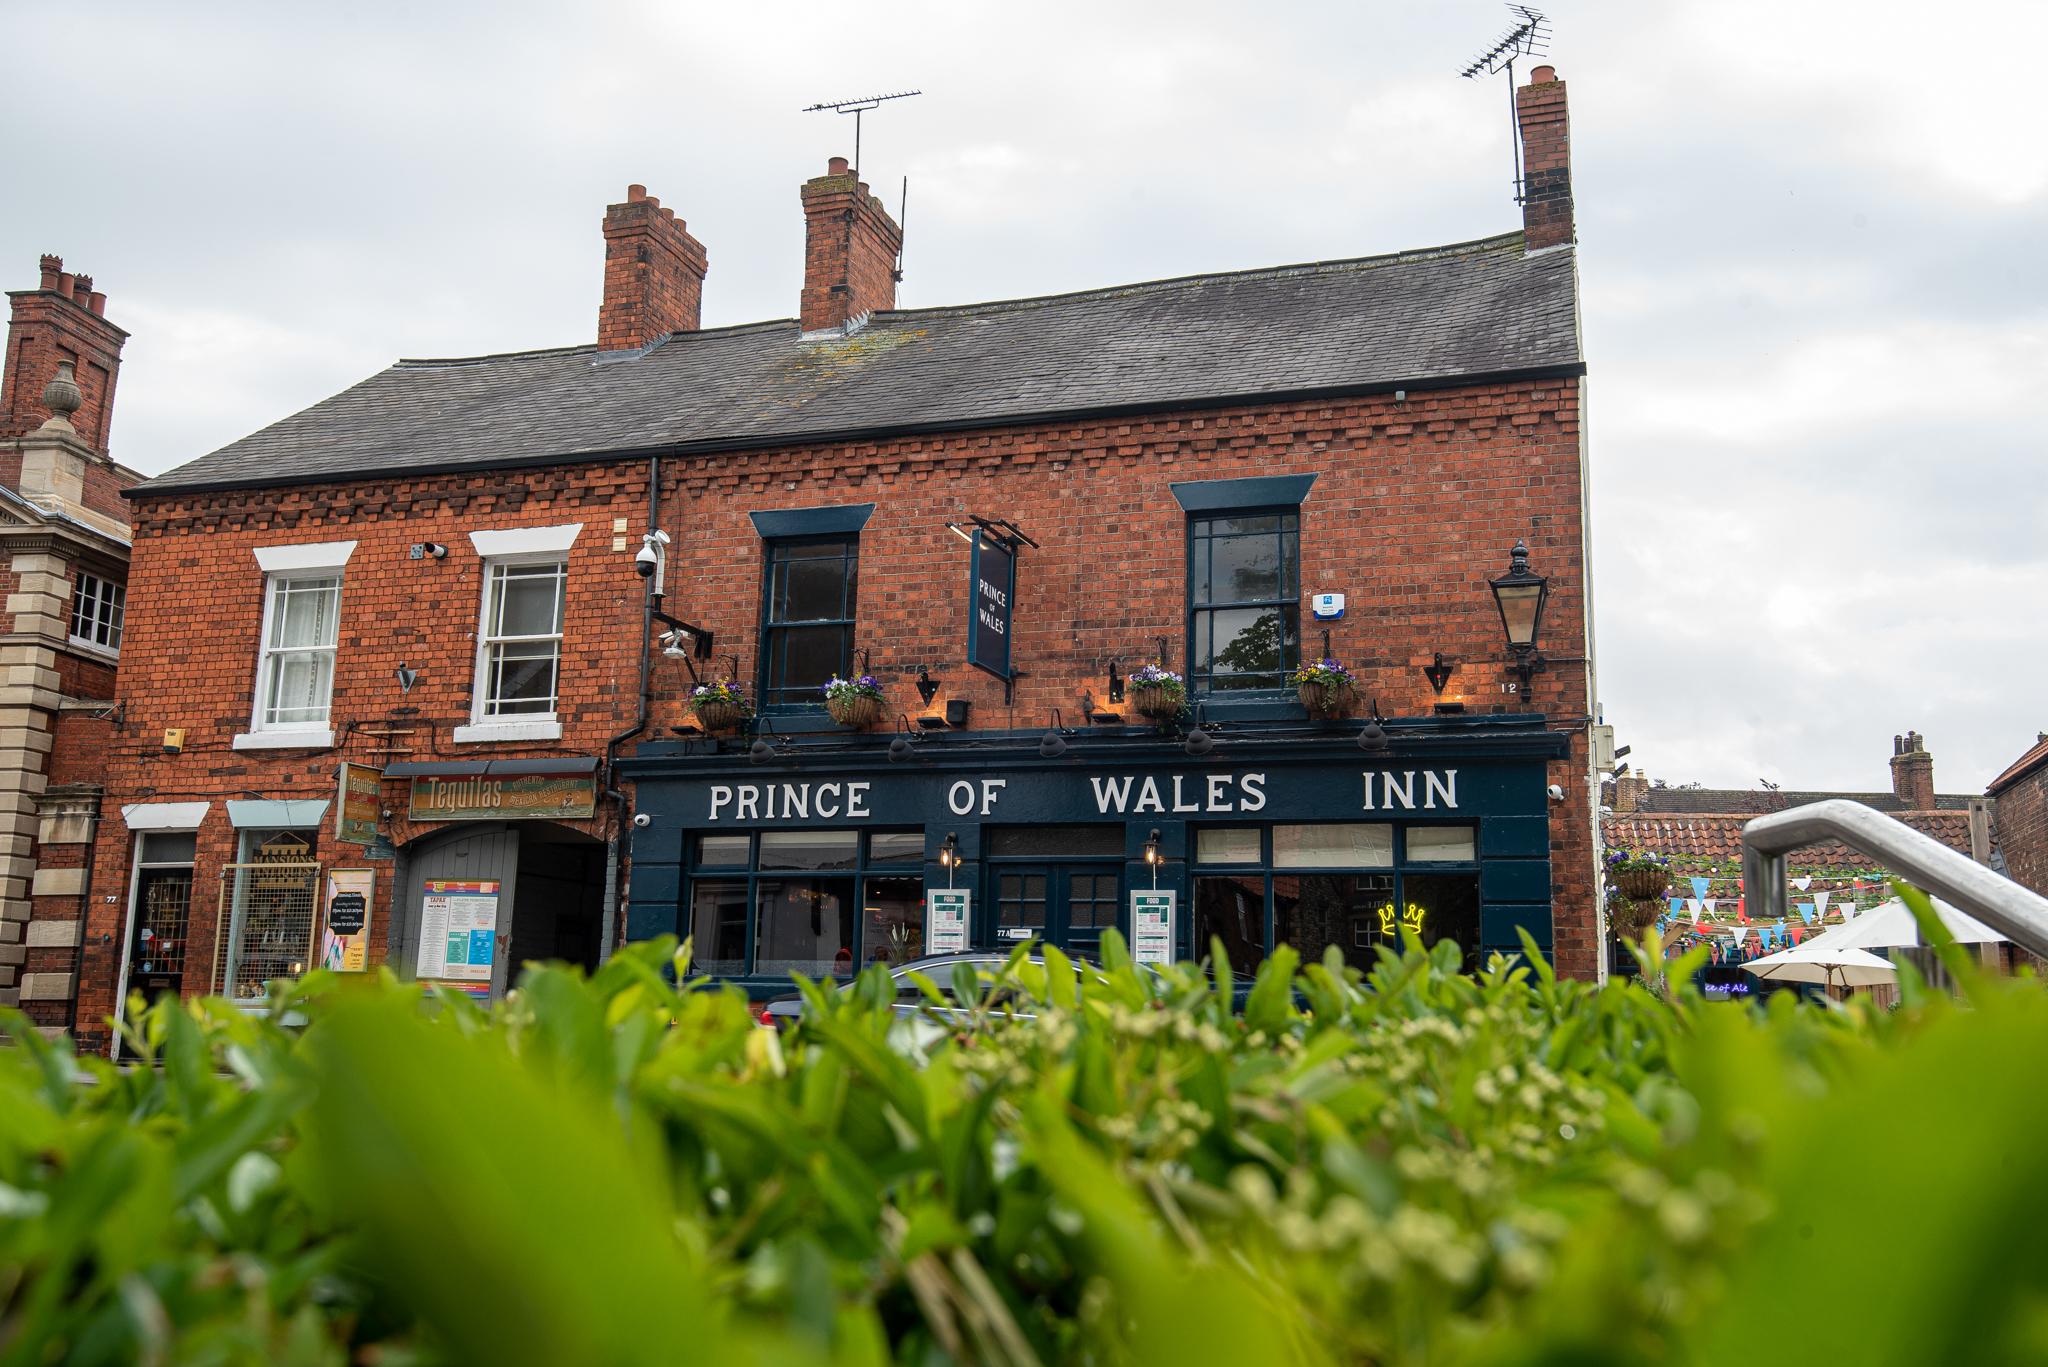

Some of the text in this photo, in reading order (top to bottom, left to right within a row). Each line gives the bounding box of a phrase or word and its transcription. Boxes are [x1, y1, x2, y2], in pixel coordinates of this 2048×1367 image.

[979, 578, 1006, 607] PRINCE
[989, 603, 996, 613] OF
[979, 607, 1004, 635] WALES
[1501, 683, 1517, 693] 12
[512, 775, 545, 788] AUTHENTIC
[539, 779, 578, 798] RESTAURANT
[428, 776, 502, 813] Tequilas
[708, 769, 1459, 820] PRINCE OF WALES INN
[106, 895, 117, 903] 77
[1719, 983, 1730, 993] of
[1731, 983, 1748, 992] Ale
